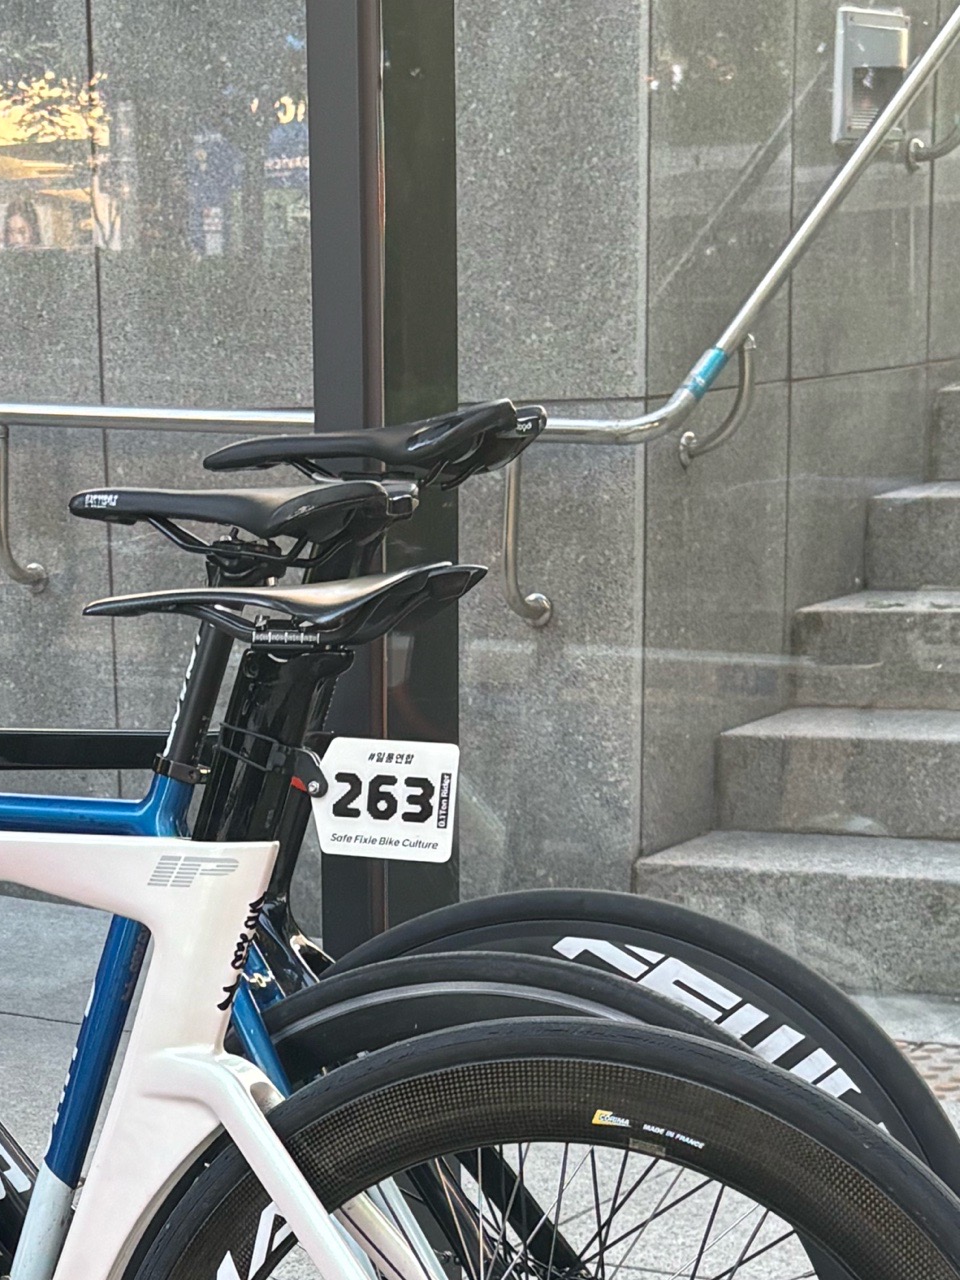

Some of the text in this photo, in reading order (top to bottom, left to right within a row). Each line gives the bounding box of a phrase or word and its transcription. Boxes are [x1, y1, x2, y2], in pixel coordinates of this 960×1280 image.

[332, 771, 435, 824] 263
[330, 832, 352, 843] Safe
[378, 837, 400, 847] Bike
[402, 838, 439, 850] Culture
[642, 1123, 665, 1135] MADE
[675, 1133, 705, 1149] FRANCE
